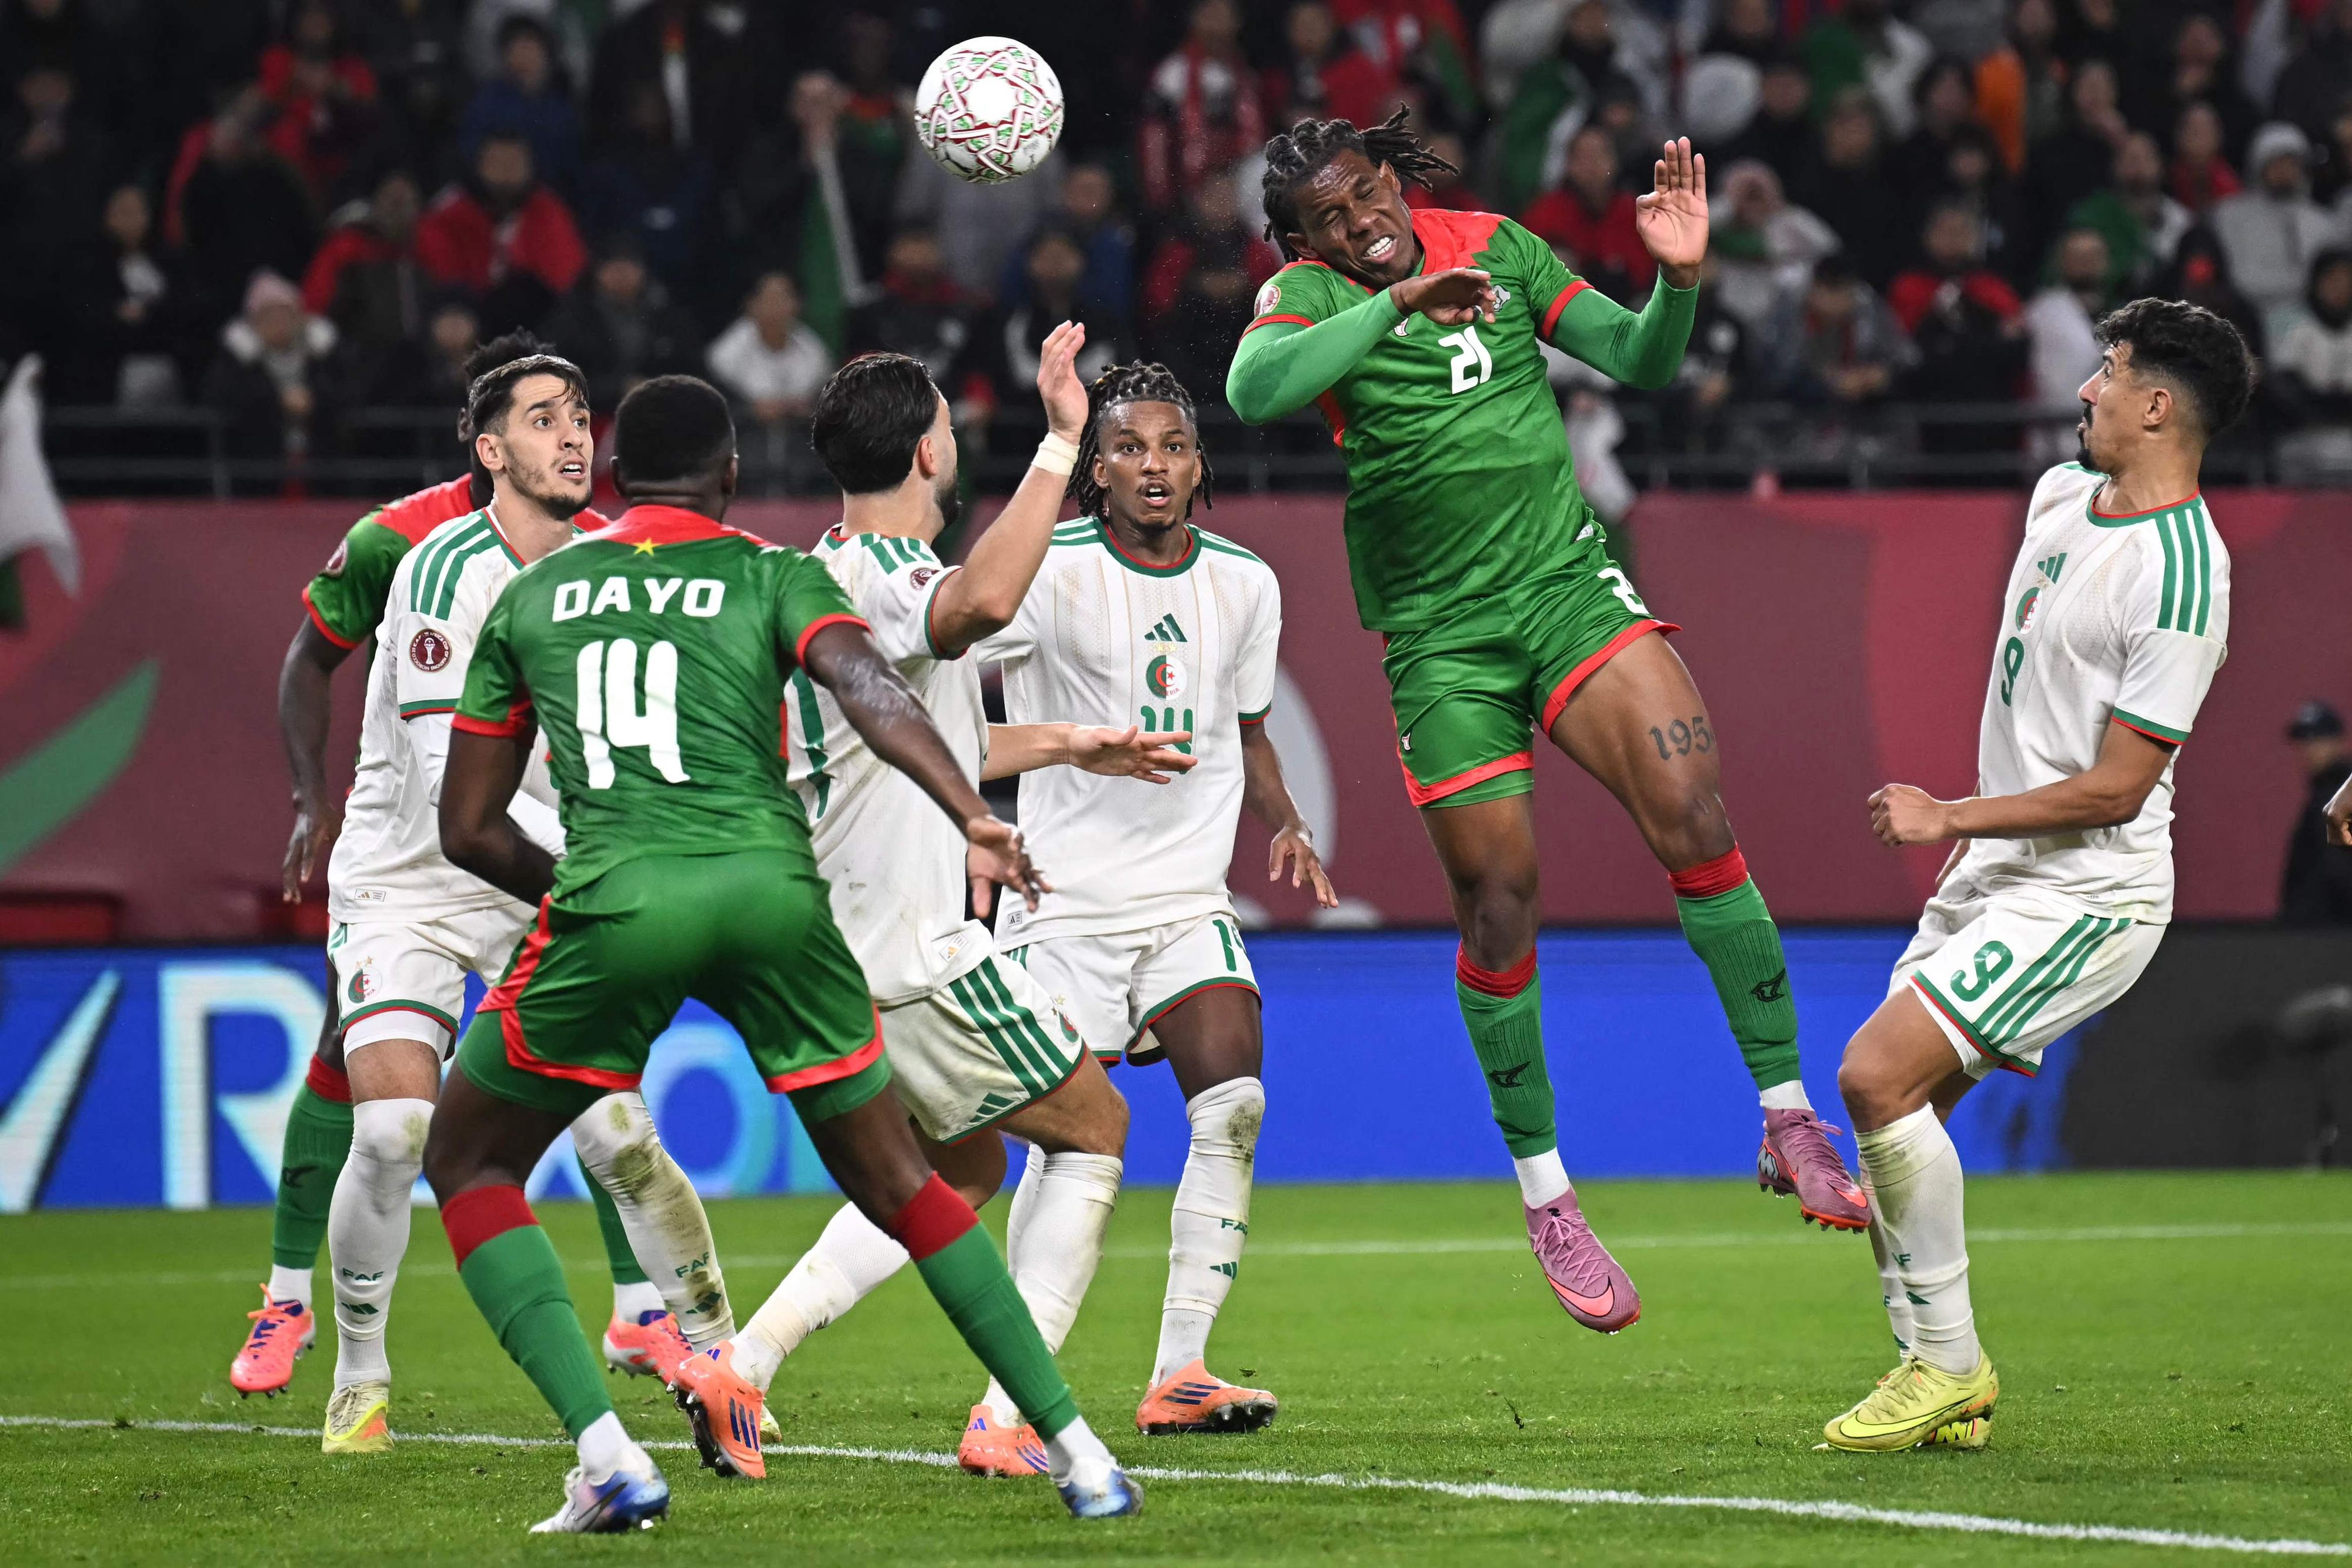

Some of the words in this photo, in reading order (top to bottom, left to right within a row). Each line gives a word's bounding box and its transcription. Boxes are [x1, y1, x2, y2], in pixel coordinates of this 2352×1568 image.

[1438, 325, 1492, 395] 21
[552, 577, 726, 623] DAYO
[2001, 636, 2025, 707] 9
[576, 638, 691, 790] 14
[1950, 940, 2014, 1002] 9
[342, 1267, 384, 1281] FAF
[674, 1251, 709, 1278] FAF
